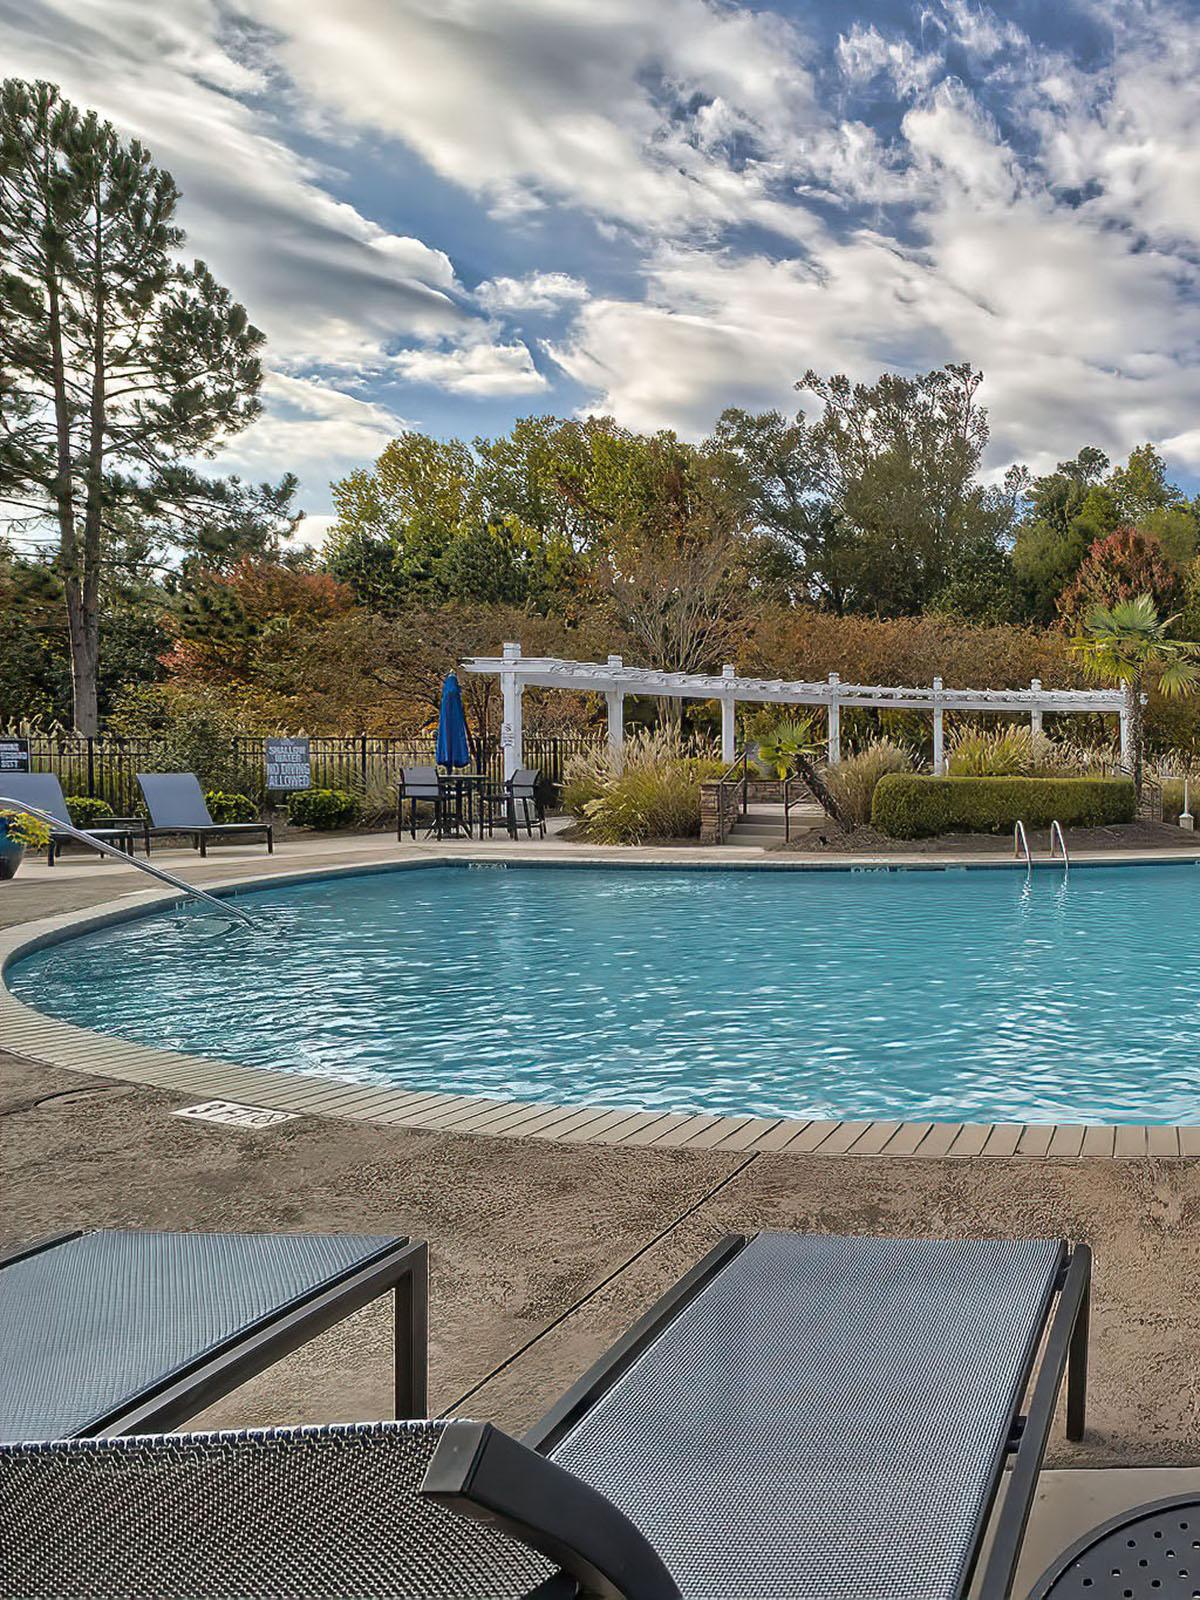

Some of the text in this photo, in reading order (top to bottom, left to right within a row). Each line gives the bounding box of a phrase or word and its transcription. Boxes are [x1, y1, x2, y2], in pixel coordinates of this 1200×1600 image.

[269, 775, 310, 786] ALLOWED
[187, 1103, 263, 1122] 3 FT
